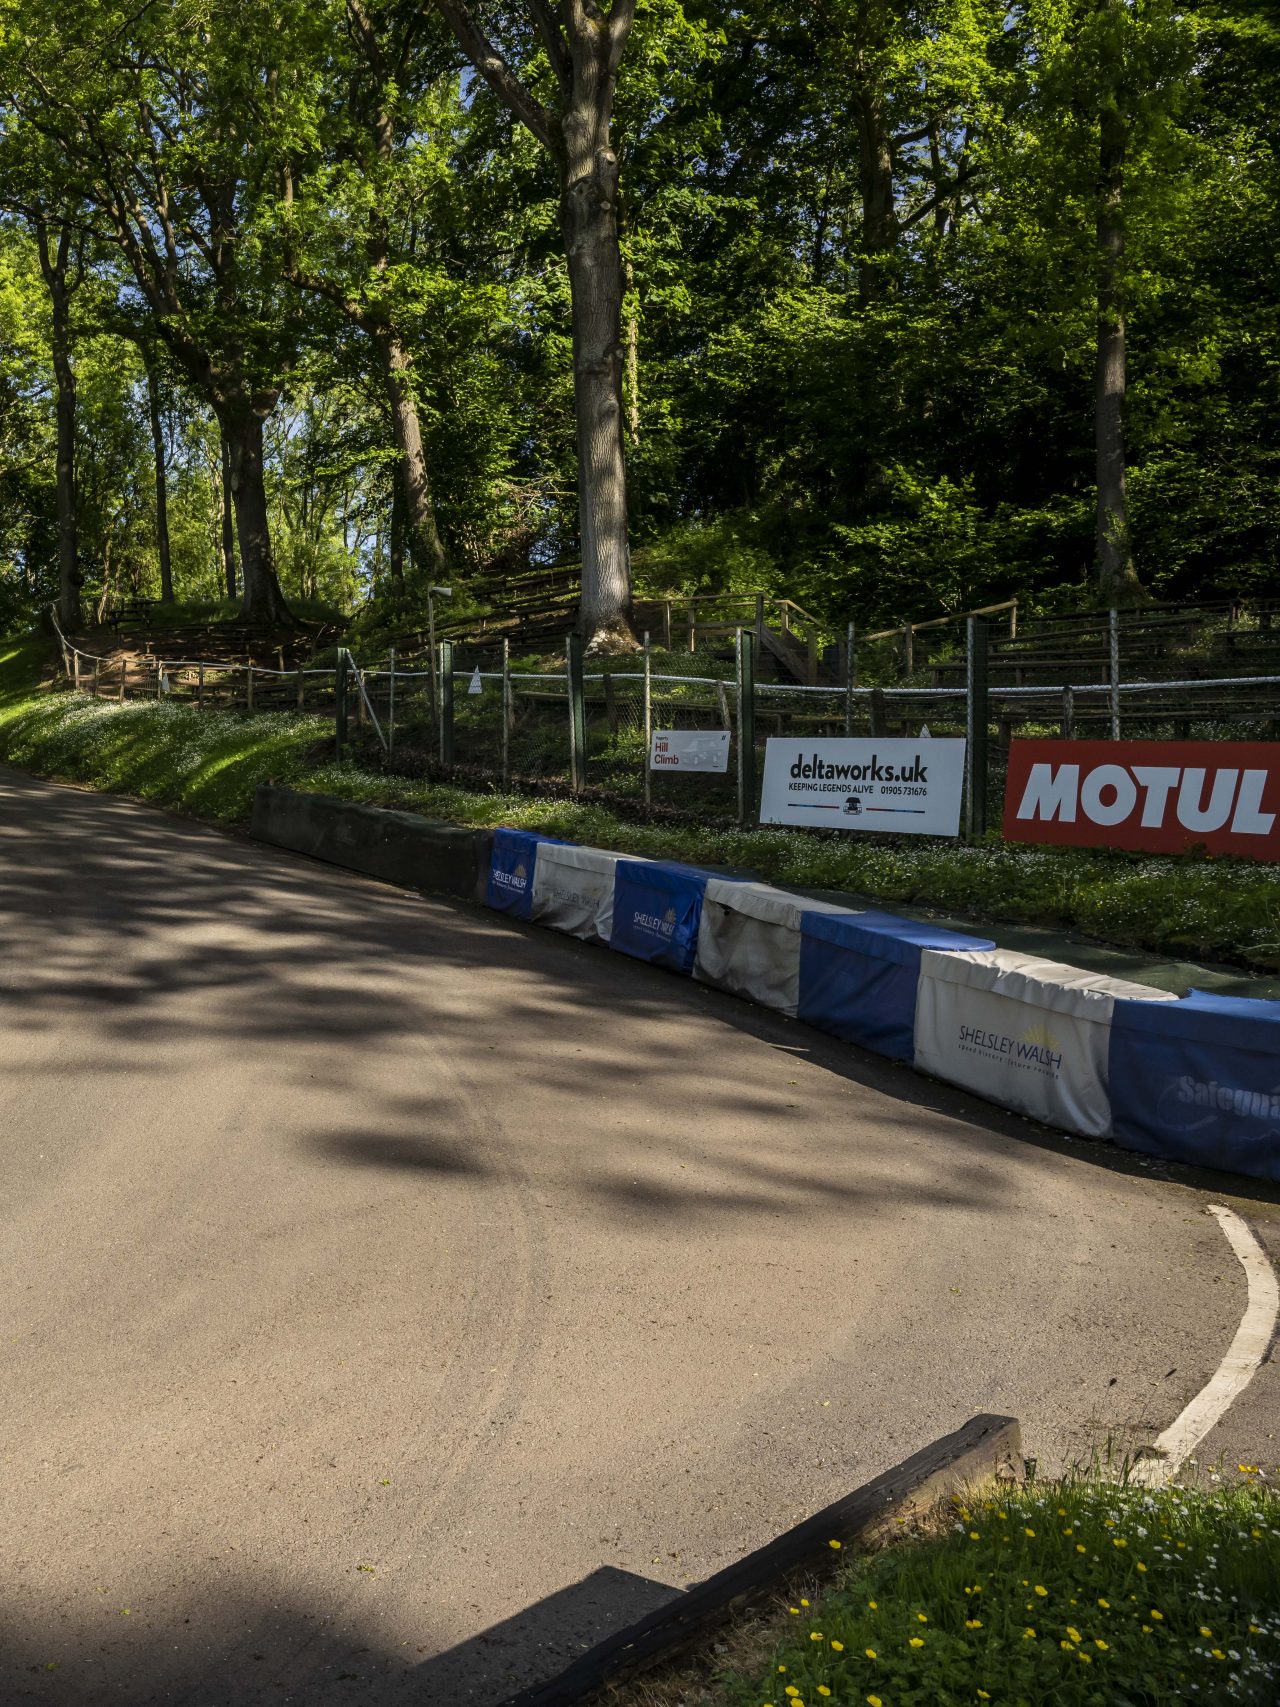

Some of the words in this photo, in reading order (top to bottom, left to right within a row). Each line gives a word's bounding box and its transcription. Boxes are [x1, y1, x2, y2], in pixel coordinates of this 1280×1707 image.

[655, 742, 669, 752] Hill
[654, 754, 679, 765] Climb
[790, 753, 929, 783] deltaworks.uk
[788, 782, 818, 792] KEEPING
[819, 783, 851, 793] LEGENDS
[852, 785, 874, 794] ALIVE
[880, 785, 902, 795] 01905
[1016, 763, 1276, 835] MOTUL
[633, 911, 661, 930] SHELSLEY
[959, 1025, 1015, 1054] SHELSLEY
[1017, 1041, 1063, 1069] WALSH
